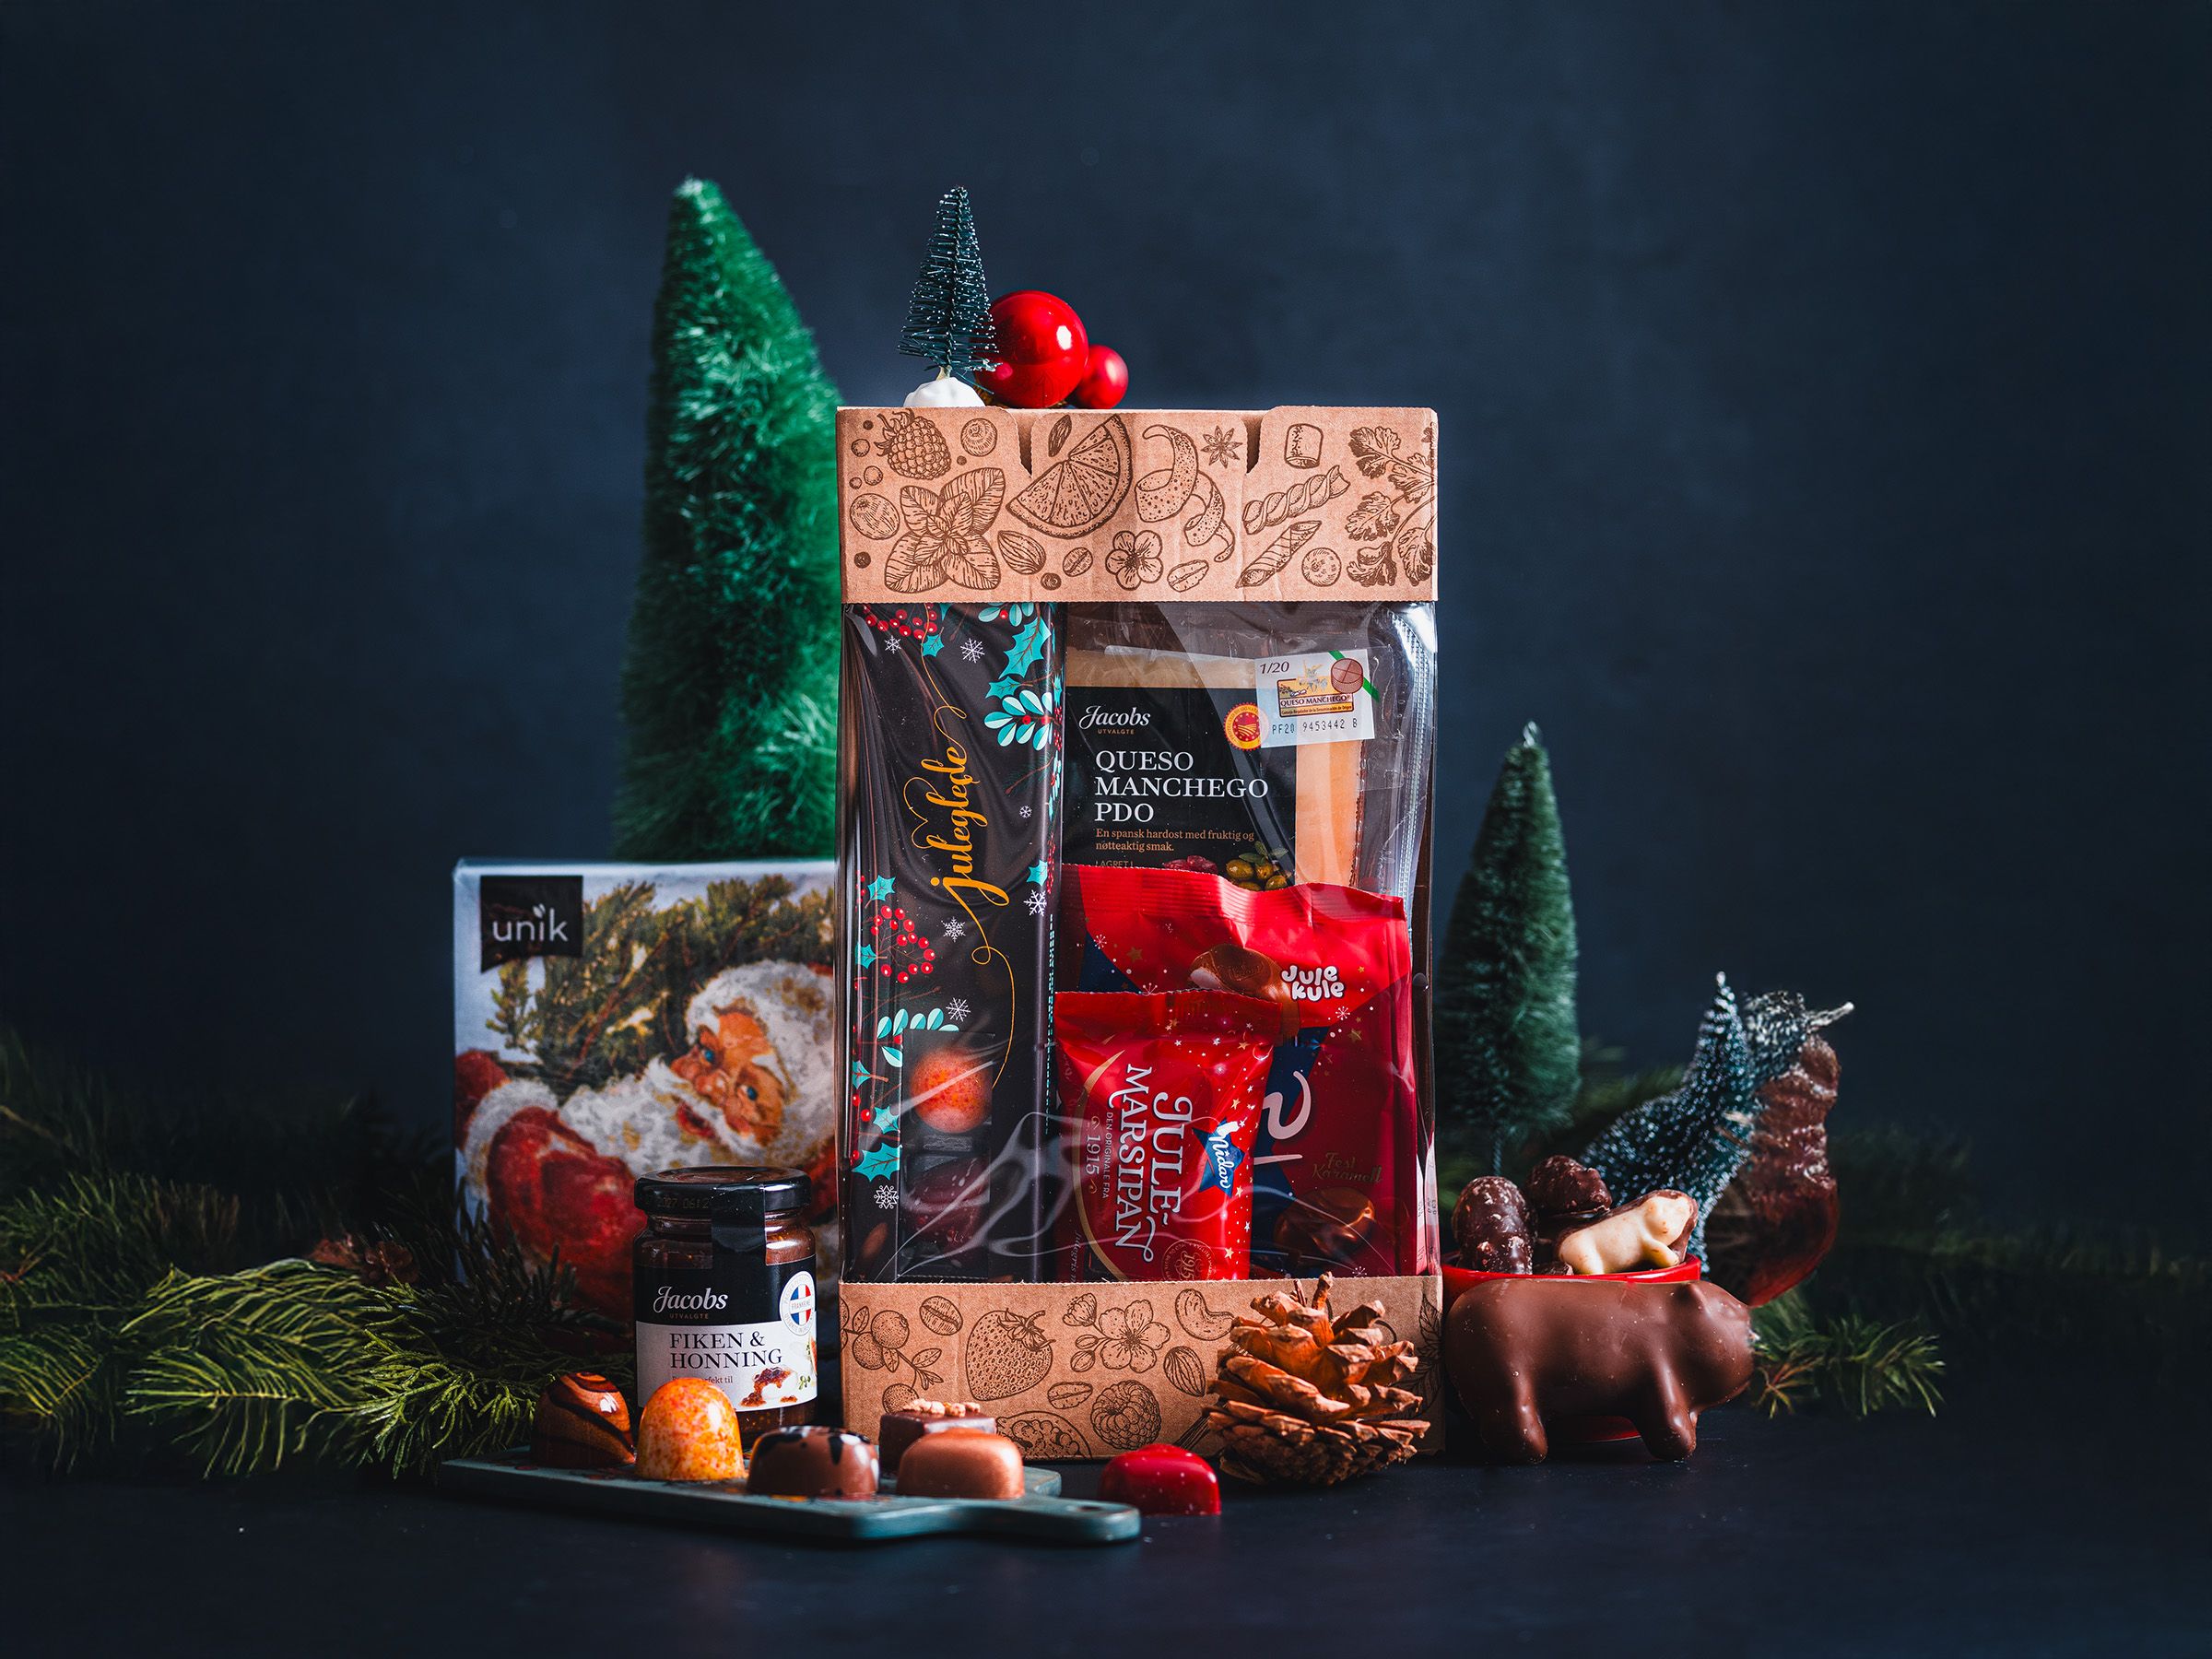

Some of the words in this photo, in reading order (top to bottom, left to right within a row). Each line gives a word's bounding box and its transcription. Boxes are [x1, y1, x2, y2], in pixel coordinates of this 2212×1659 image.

[1259, 661, 1290, 675] 1/20
[1280, 699, 1305, 708] QUESO
[1305, 694, 1347, 704] MANCHEGO
[1078, 705, 1151, 730] Jacobs
[1272, 723, 1295, 735] PF20
[1302, 718, 1346, 733] 9453442
[1095, 750, 1194, 773] QUESO
[1094, 776, 1269, 798] MANCHEGO
[1094, 802, 1155, 823] PDO
[1096, 828, 1110, 838] En
[1112, 829, 1144, 840] spansk
[1146, 830, 1183, 839] hardost
[1185, 830, 1206, 840] med
[1207, 830, 1241, 841] fruktig
[1241, 832, 1254, 841] og
[1096, 841, 1145, 853] nøtteaktig
[1146, 841, 1174, 852] smak.
[492, 903, 569, 943] unik
[1281, 965, 1338, 987] Jule
[1290, 980, 1345, 1002] kule
[1105, 1112, 1113, 1130] DEN
[1085, 1134, 1101, 1175] 1915
[1102, 1132, 1112, 1180] ORIGINALE
[1108, 1063, 1158, 1263] MARSIPAN
[1207, 1126, 1236, 1190] Nidar
[1101, 1182, 1110, 1199] FRA
[1181, 1253, 1195, 1281] 1915
[653, 1286, 729, 1313] Jacobs
[669, 1333, 743, 1349] FIKEN
[749, 1331, 765, 1347] &
[670, 1348, 782, 1369] HONNING
[724, 1375, 734, 1383] til
